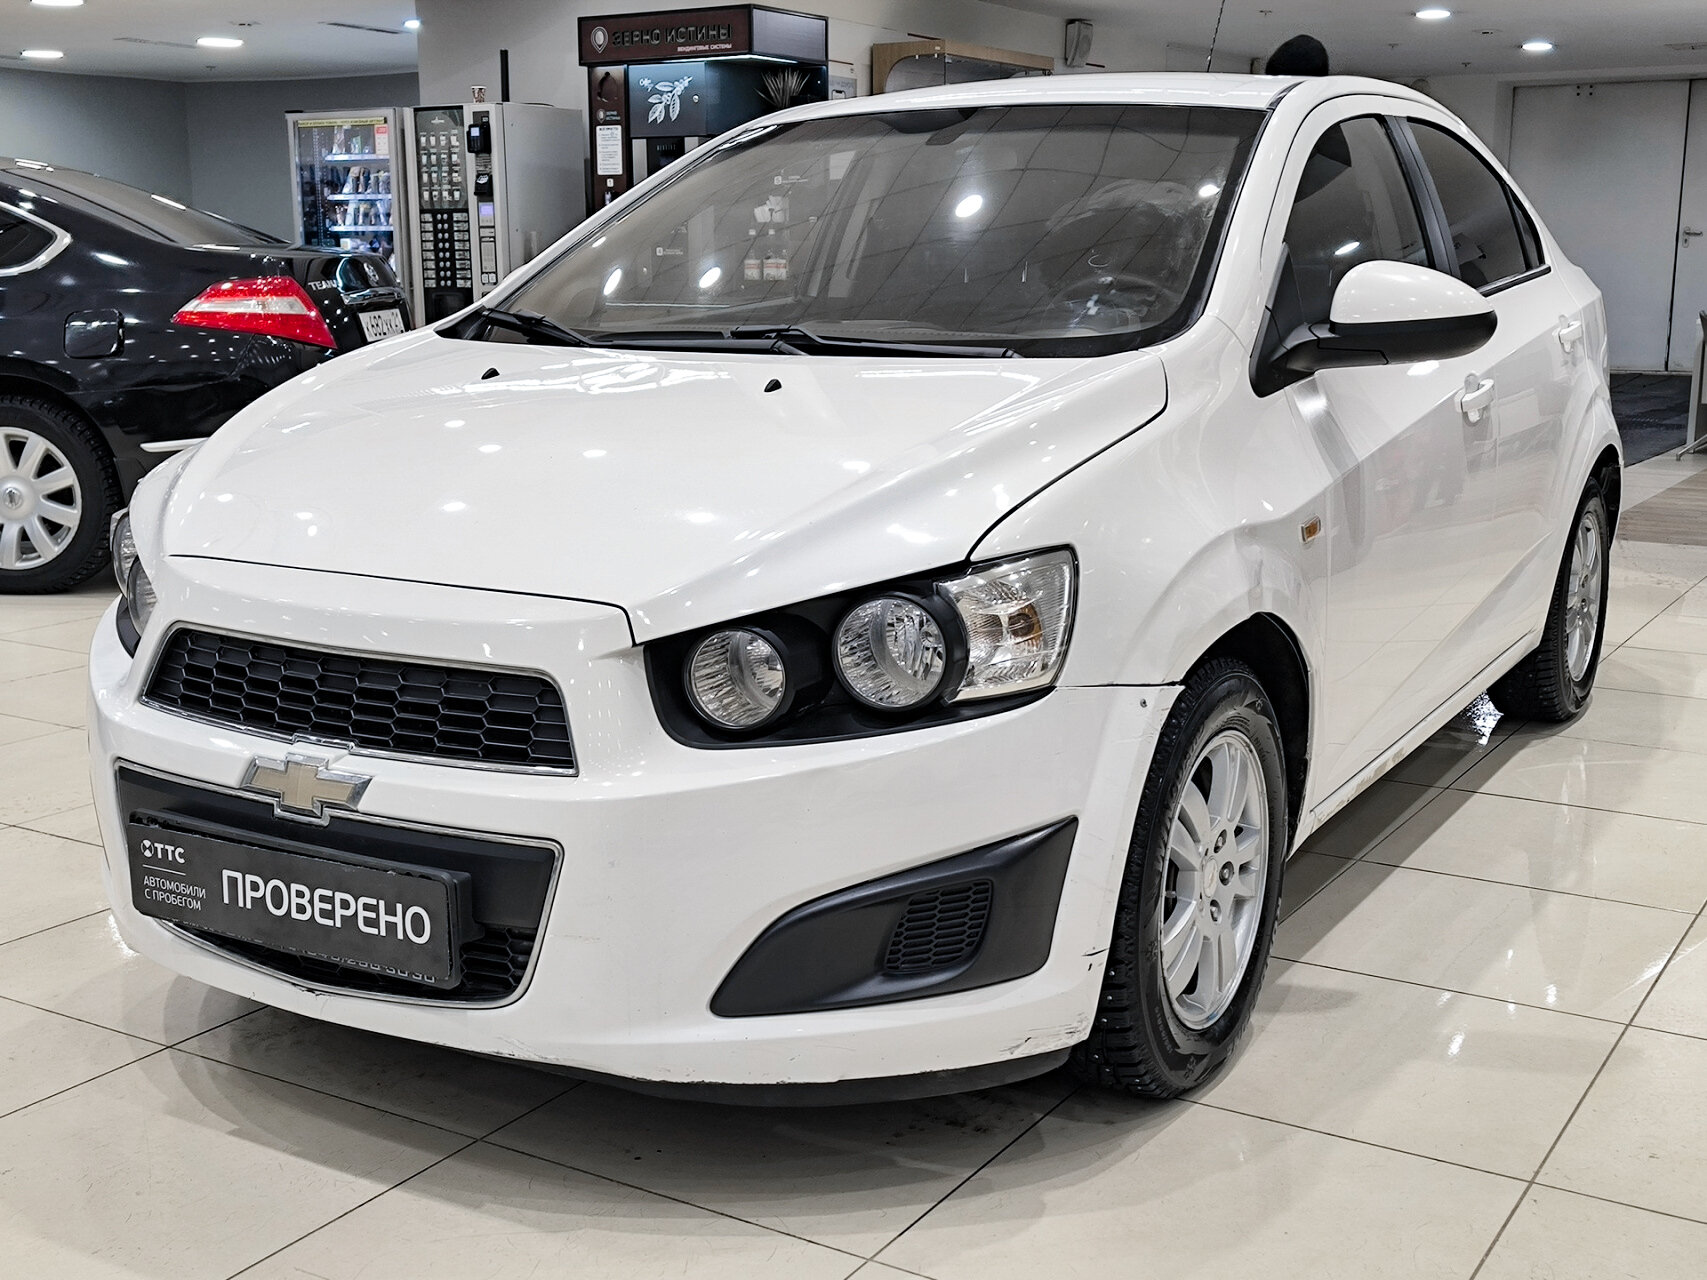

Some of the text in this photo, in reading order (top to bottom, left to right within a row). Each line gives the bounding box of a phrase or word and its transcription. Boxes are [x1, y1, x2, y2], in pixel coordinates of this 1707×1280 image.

[612, 24, 732, 46] ЗЕРНО ИСТИНЫ
[308, 279, 338, 291] TEAN
[154, 842, 186, 864] ТТС
[143, 875, 206, 899] АВТОМОБИЛИ
[144, 888, 202, 911] С ПРОБЕГОМ
[222, 868, 431, 945] ПРОВЕРЕНО
